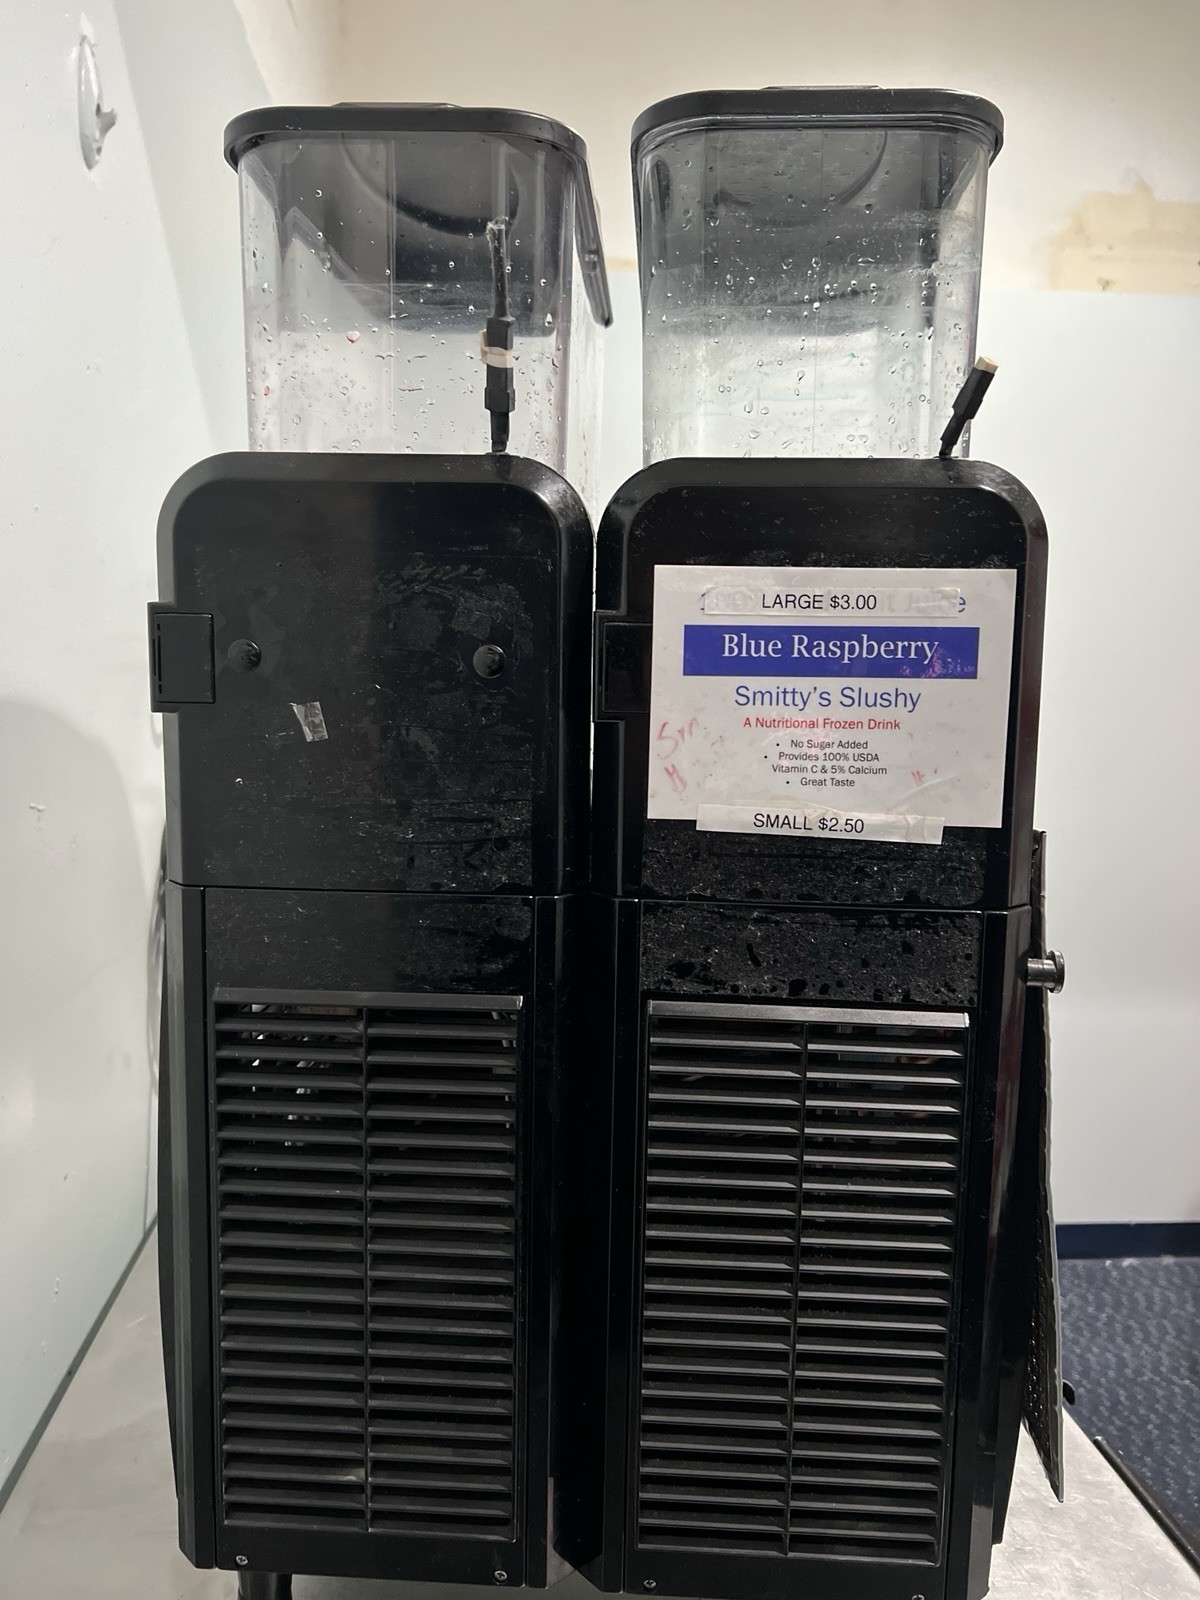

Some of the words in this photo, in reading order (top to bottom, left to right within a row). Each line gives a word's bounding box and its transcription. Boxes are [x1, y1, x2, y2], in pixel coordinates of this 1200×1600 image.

[762, 594, 824, 610] LARGE
[830, 594, 877, 610] $3.00
[722, 633, 783, 658] Blue
[791, 634, 939, 664] Raspberry
[840, 687, 921, 713] Slushy
[743, 718, 752, 728] A
[755, 718, 819, 730] Nutritional
[823, 718, 864, 730] Frozen
[868, 719, 901, 730] Drink
[791, 739, 804, 748] No
[806, 740, 835, 751] Sugar
[838, 740, 868, 750] Added
[778, 752, 820, 762] Provides
[822, 752, 850, 762] 100%
[852, 752, 880, 762] USDA
[772, 764, 808, 774] Vitamin
[812, 764, 819, 774] C
[821, 765, 829, 774] &
[830, 765, 846, 774] 5%
[848, 765, 888, 776] Calcium
[800, 776, 827, 786] Great
[830, 778, 856, 787] Taste
[753, 813, 812, 831] SMALL
[818, 818, 865, 834] $2.50
